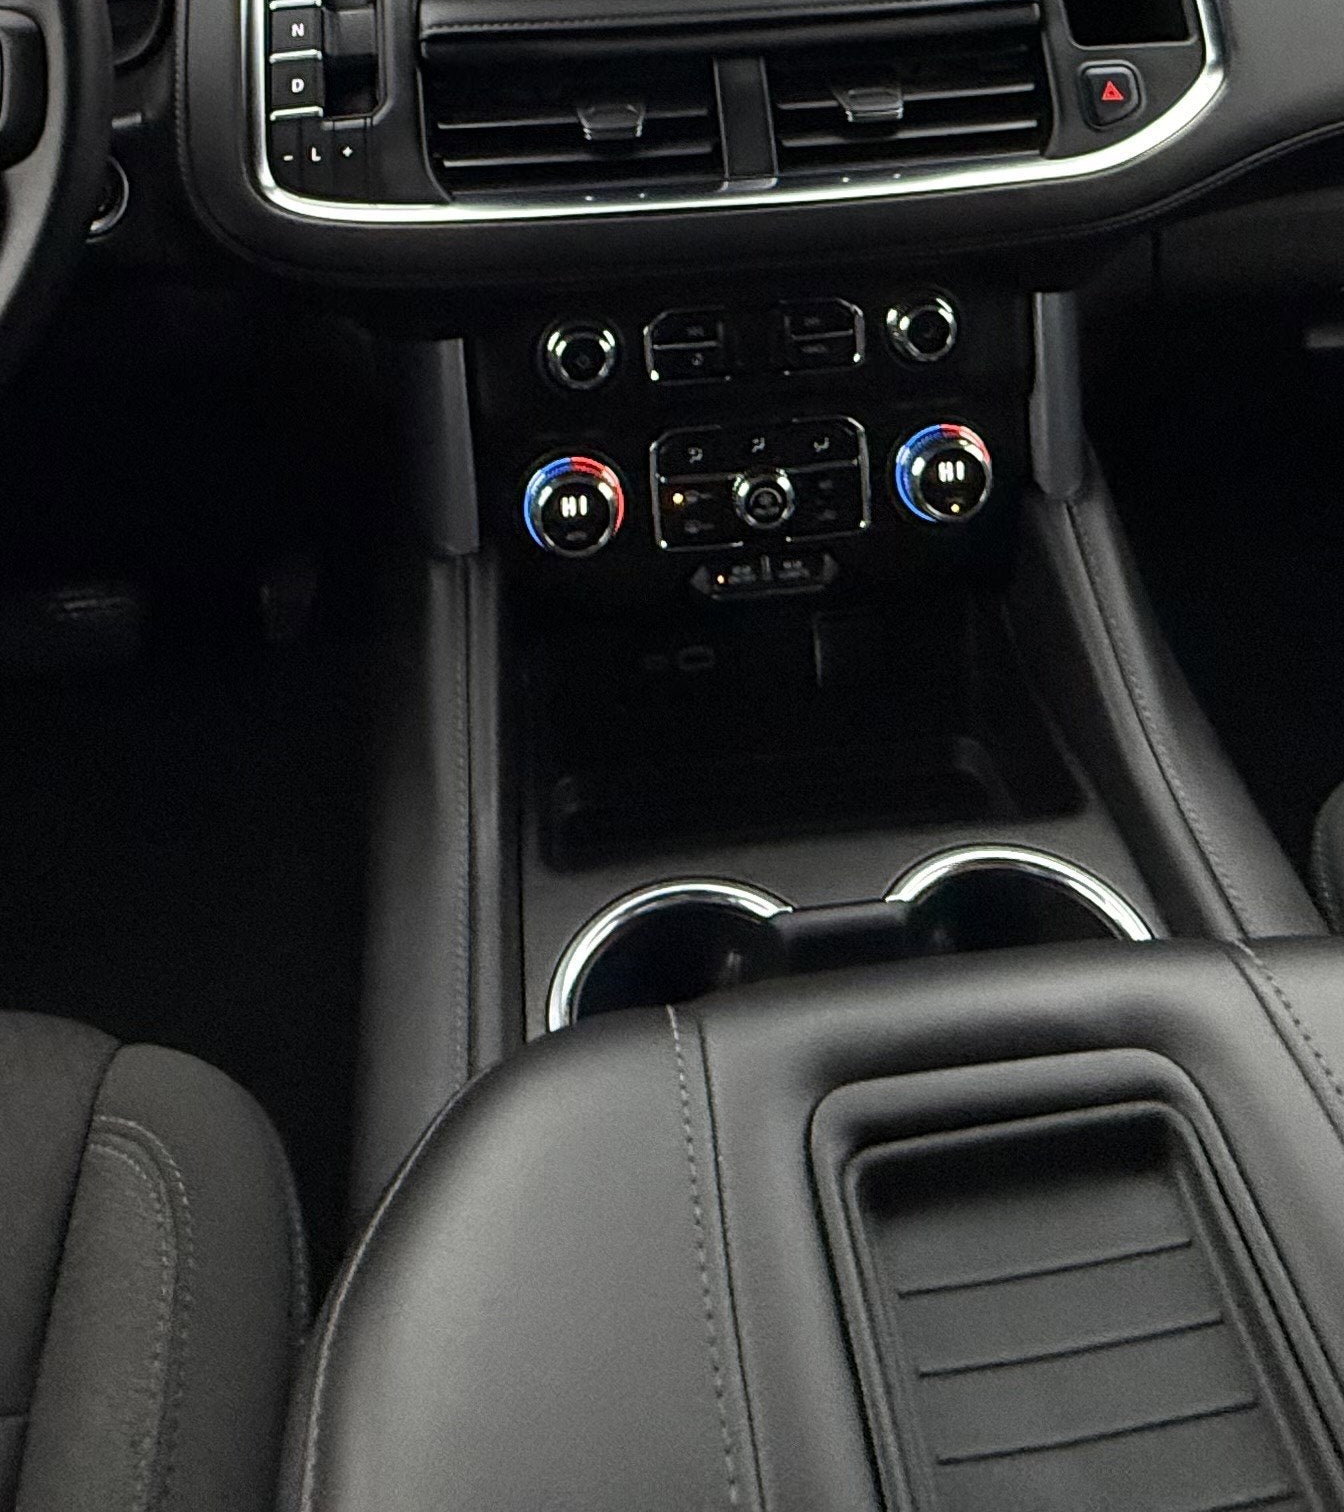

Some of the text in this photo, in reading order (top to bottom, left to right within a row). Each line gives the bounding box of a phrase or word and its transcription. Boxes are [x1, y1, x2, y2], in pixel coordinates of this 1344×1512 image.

[291, 22, 305, 38] N
[291, 78, 305, 93] D
[311, 147, 322, 162] L
[938, 461, 965, 483] HI
[561, 495, 588, 518] HI
